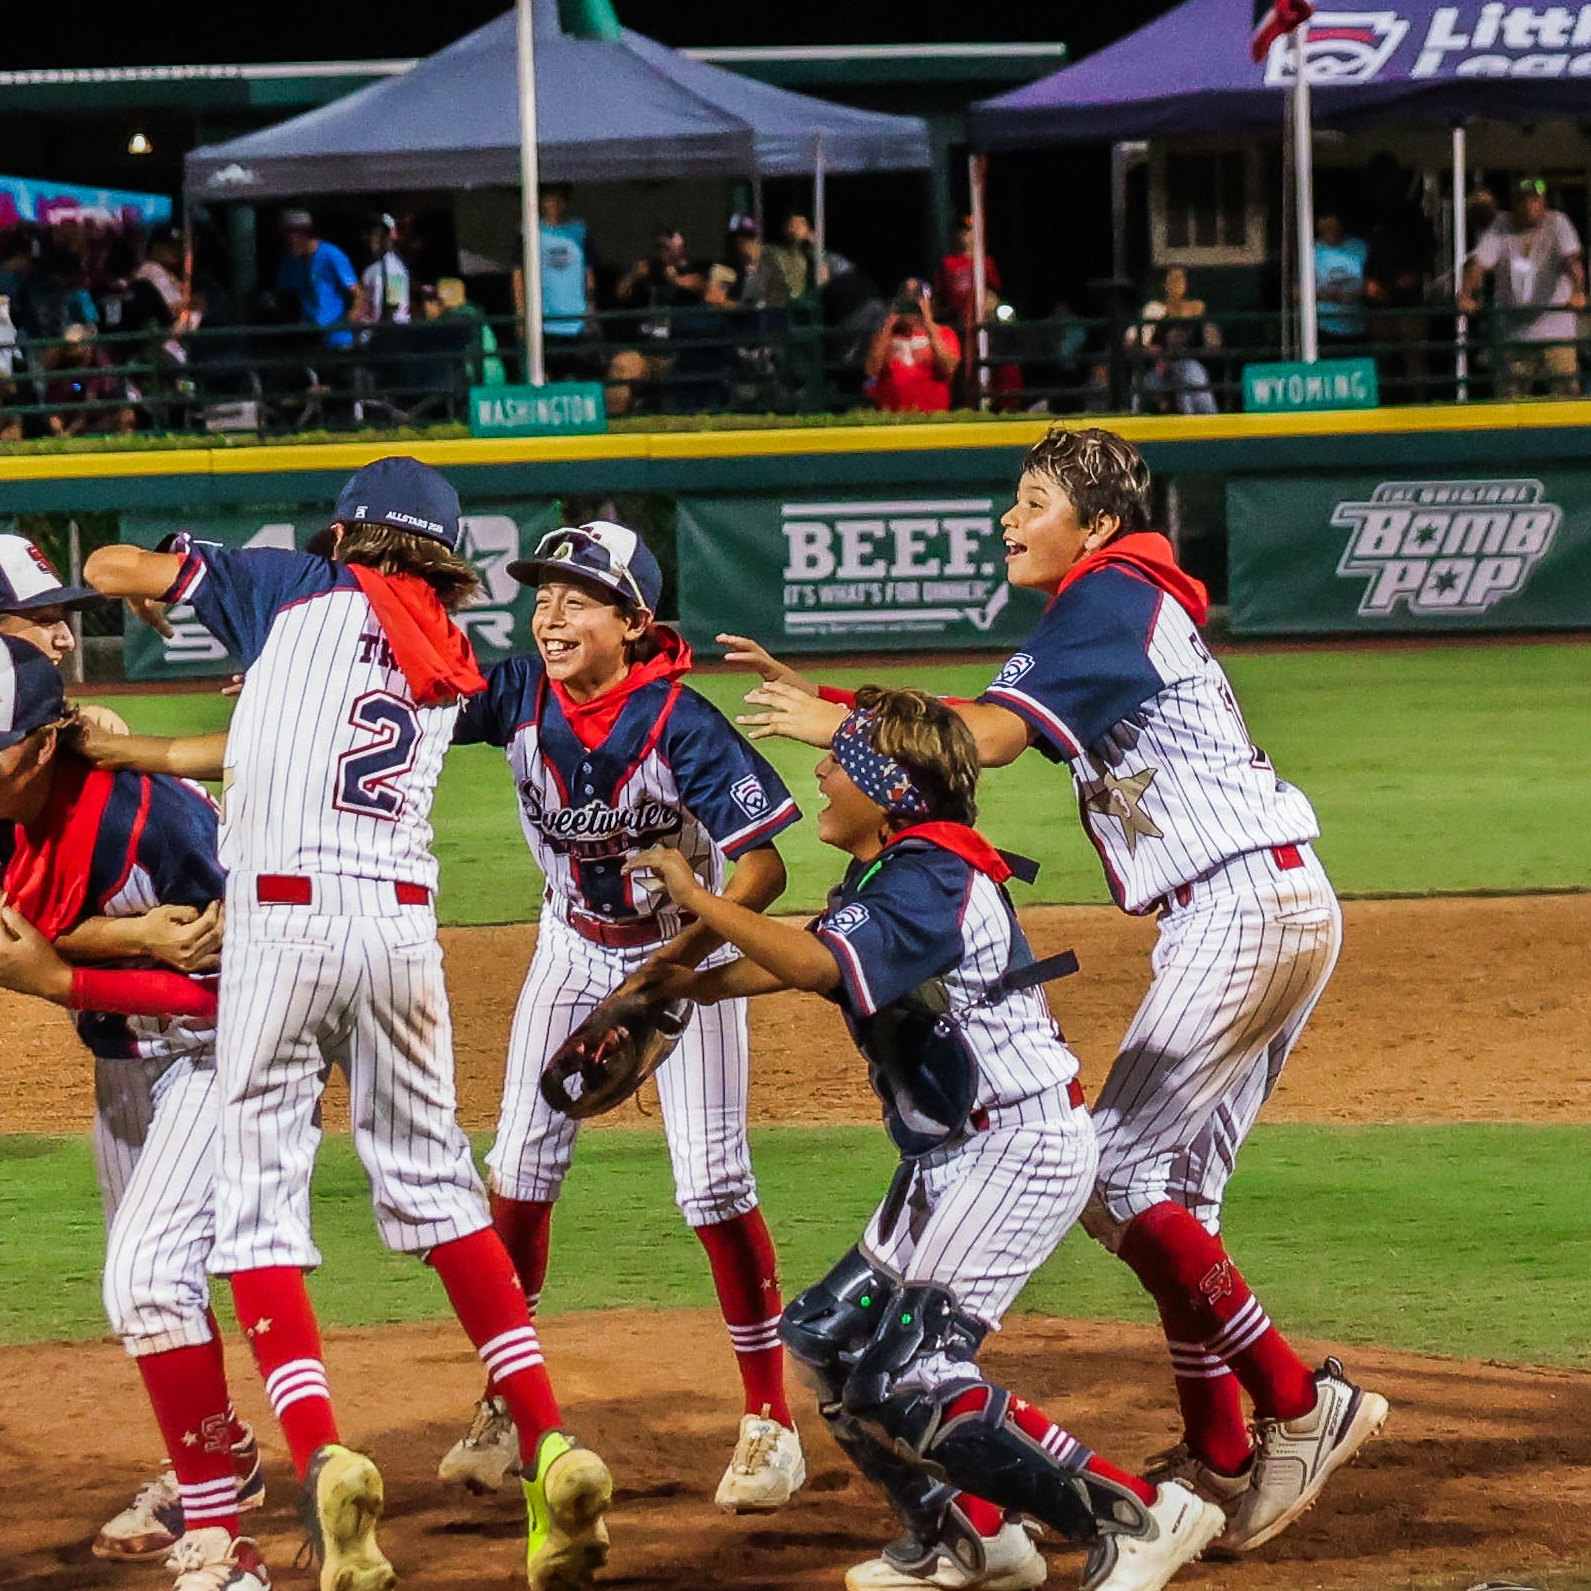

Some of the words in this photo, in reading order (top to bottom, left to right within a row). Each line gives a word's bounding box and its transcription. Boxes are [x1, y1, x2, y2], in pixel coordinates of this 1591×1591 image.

[478, 395, 596, 427] WASHINGTON
[1253, 371, 1366, 404] WYOMING
[782, 517, 995, 581] BEEF.
[1343, 510, 1555, 555] BOMB
[1348, 558, 1523, 607] POP
[332, 688, 424, 822] 2
[519, 778, 683, 840] Sweetwater
